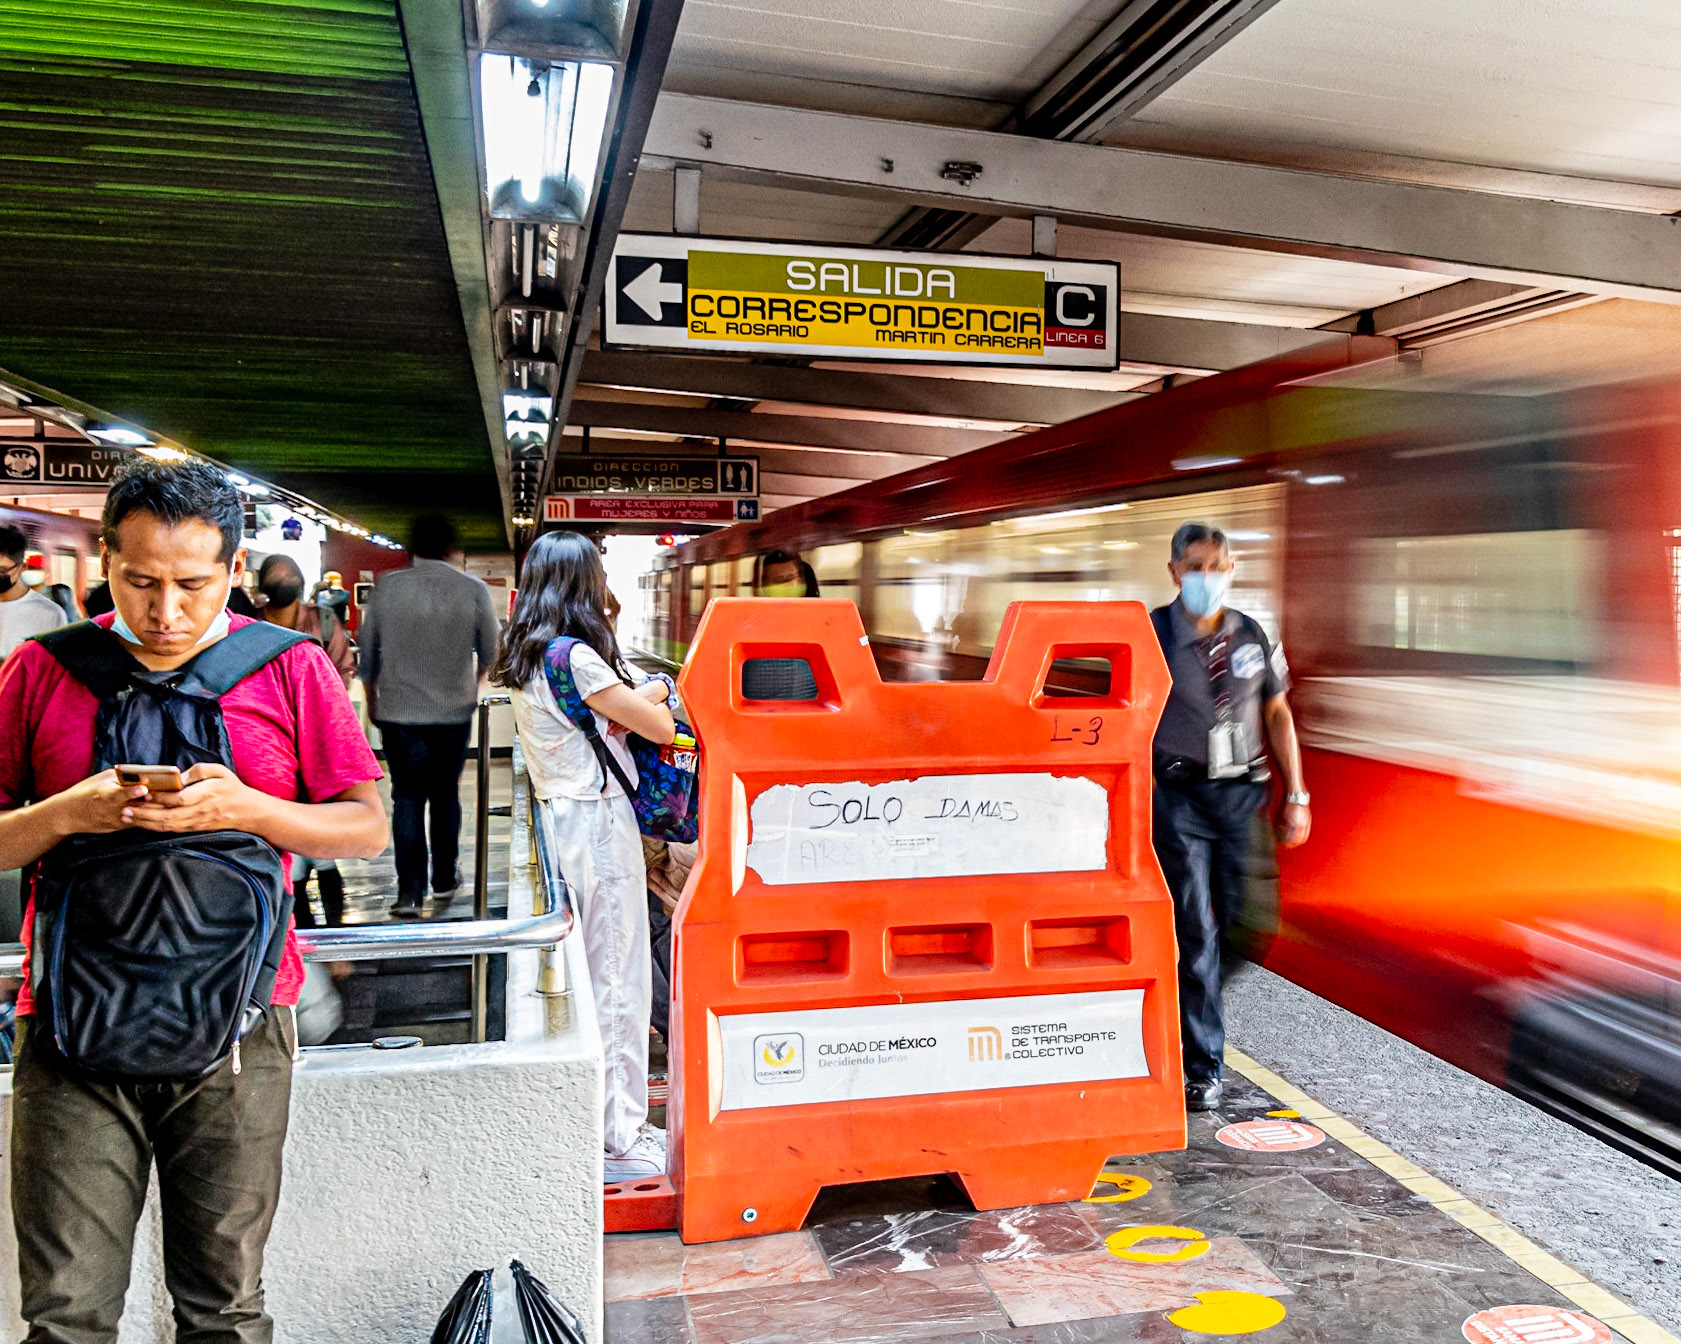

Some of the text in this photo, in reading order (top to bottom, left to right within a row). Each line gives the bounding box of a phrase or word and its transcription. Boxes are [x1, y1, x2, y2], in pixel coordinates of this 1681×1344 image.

[786, 260, 955, 299] SALIDA
[690, 294, 1042, 335] CORRESPONDENCIA
[1056, 285, 1095, 327] C
[690, 320, 809, 338] EL ROSARIO
[875, 329, 1042, 350] MARTIN CARRERA
[1045, 331, 1104, 345] LINEA 6
[593, 462, 680, 472] DIRECCION
[557, 475, 714, 490] INDIOS VERDES
[625, 500, 686, 509] EXCLUSIVA
[688, 501, 719, 509] PARA
[601, 509, 658, 518] MUJERES
[1049, 715, 1103, 746] L-3
[808, 789, 1020, 829] SOLO DAMAS
[1011, 1022, 1068, 1035] SISTEMA
[818, 1036, 937, 1056] CIUDAD DE MÉXICO
[1011, 1031, 1117, 1048] DE TRANSPORTE
[1012, 1045, 1084, 1059] COLECTIVO
